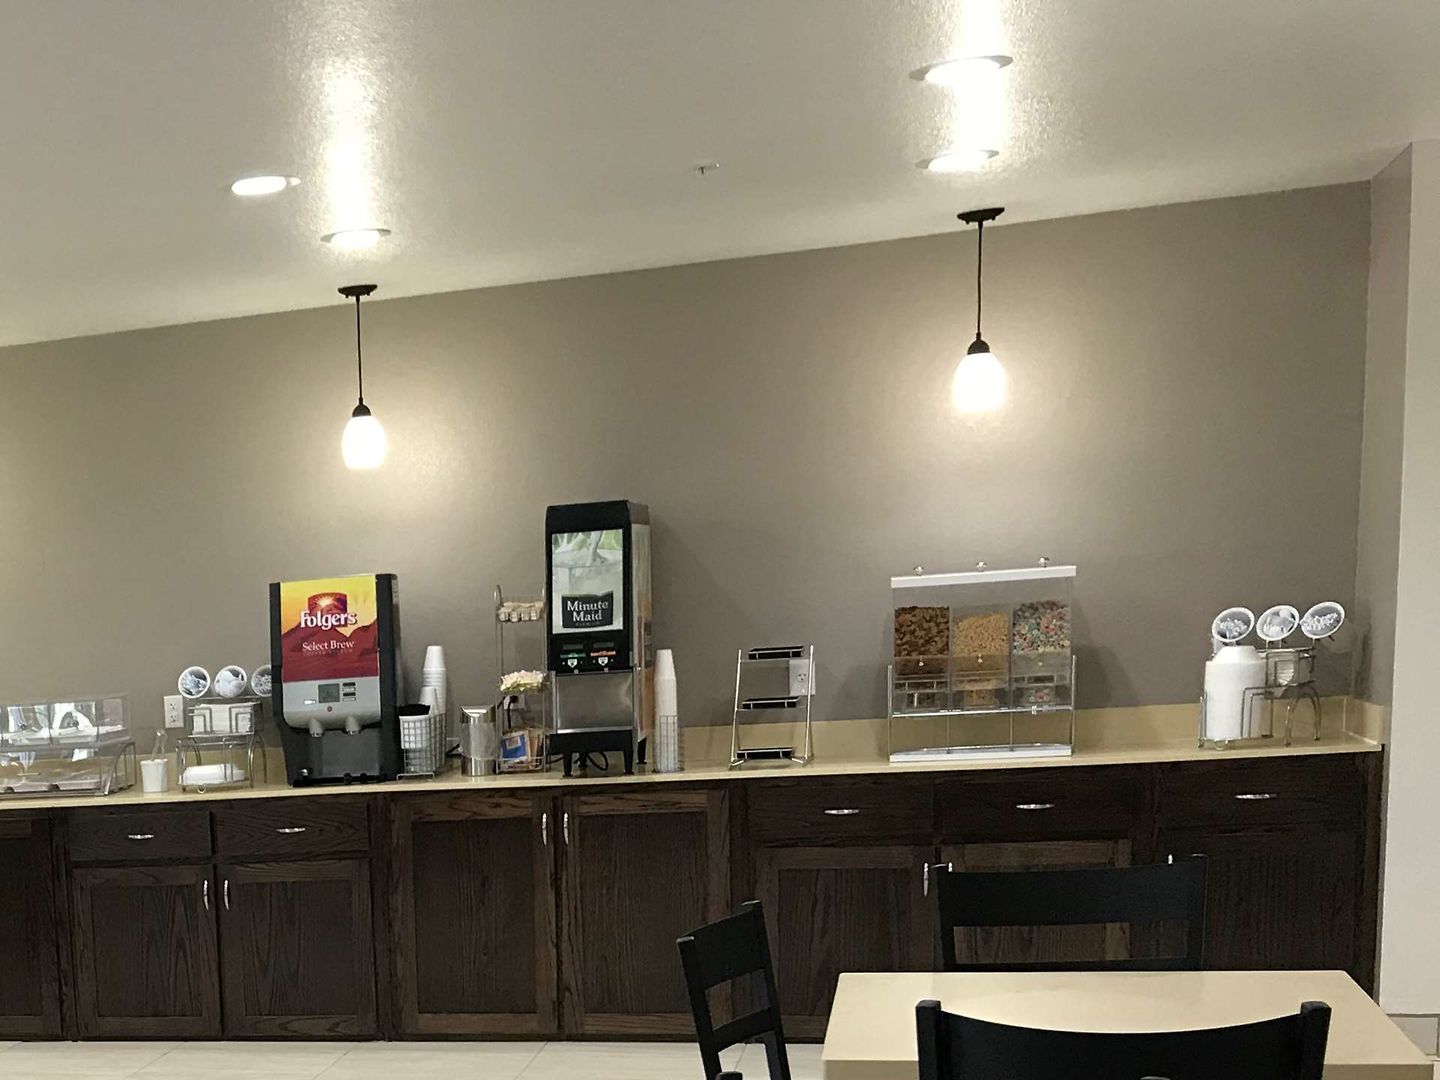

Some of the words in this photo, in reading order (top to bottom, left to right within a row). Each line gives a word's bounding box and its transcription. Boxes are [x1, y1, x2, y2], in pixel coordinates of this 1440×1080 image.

[567, 600, 608, 611] Minute
[300, 610, 357, 630] Folgers
[573, 610, 602, 621] Maid
[302, 641, 328, 651] Select
[330, 640, 354, 650] Brew
